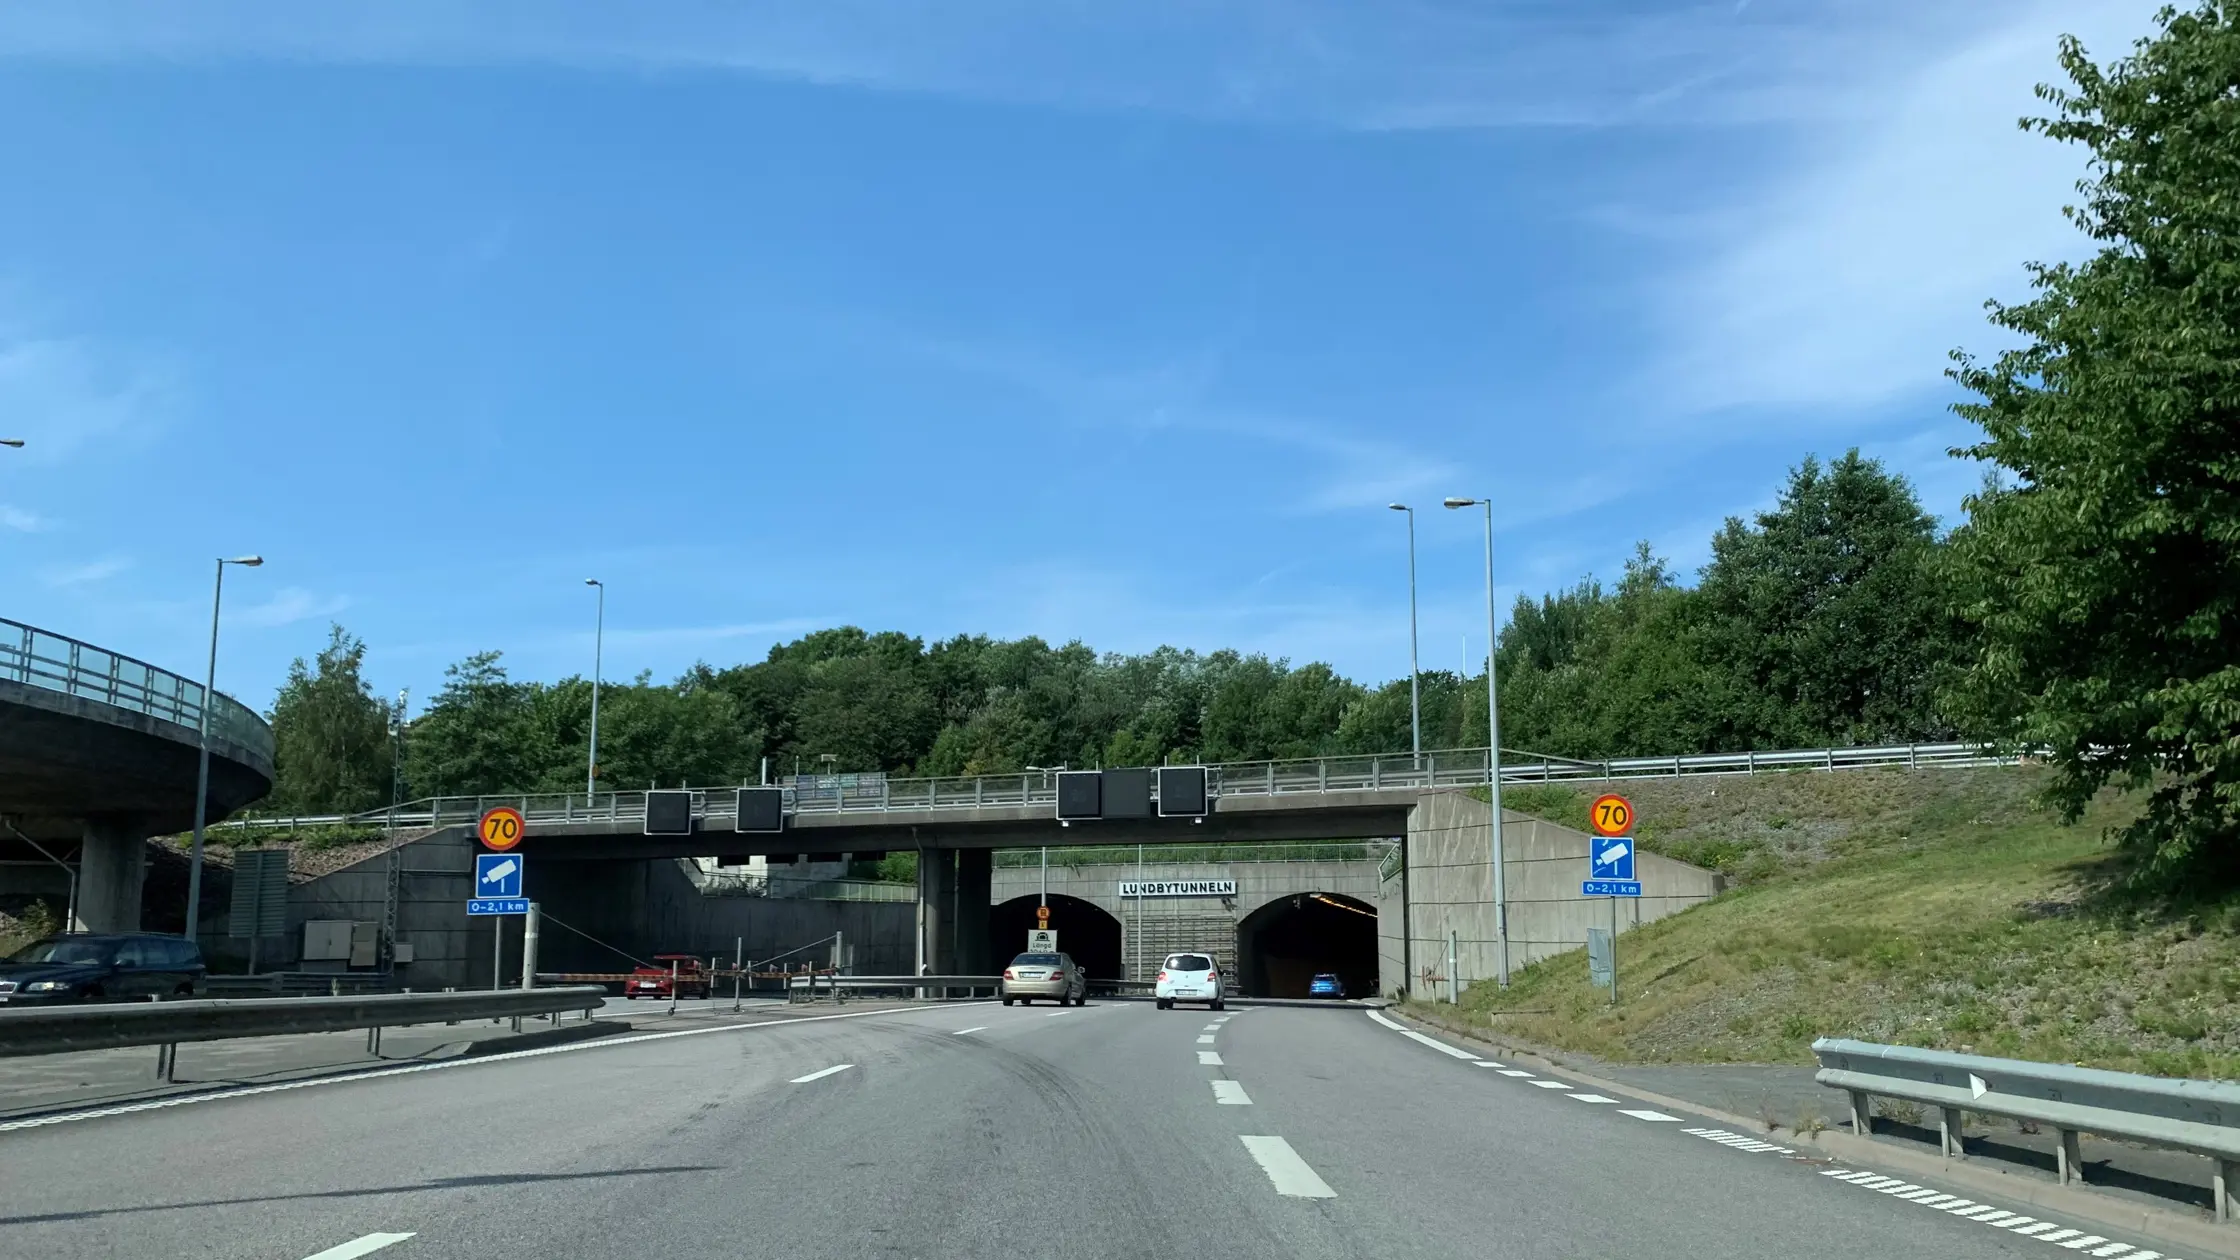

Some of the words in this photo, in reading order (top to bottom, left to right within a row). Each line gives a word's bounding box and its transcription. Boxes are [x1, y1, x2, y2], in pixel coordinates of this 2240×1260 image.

[1600, 805, 1628, 826] 70
[489, 818, 518, 839] 70
[1122, 881, 1233, 895] LUNDBYTUNNELN
[1586, 884, 1617, 893] 0-2,1
[1621, 885, 1637, 893] km
[471, 902, 503, 912] 0-2,1
[507, 902, 524, 910] km
